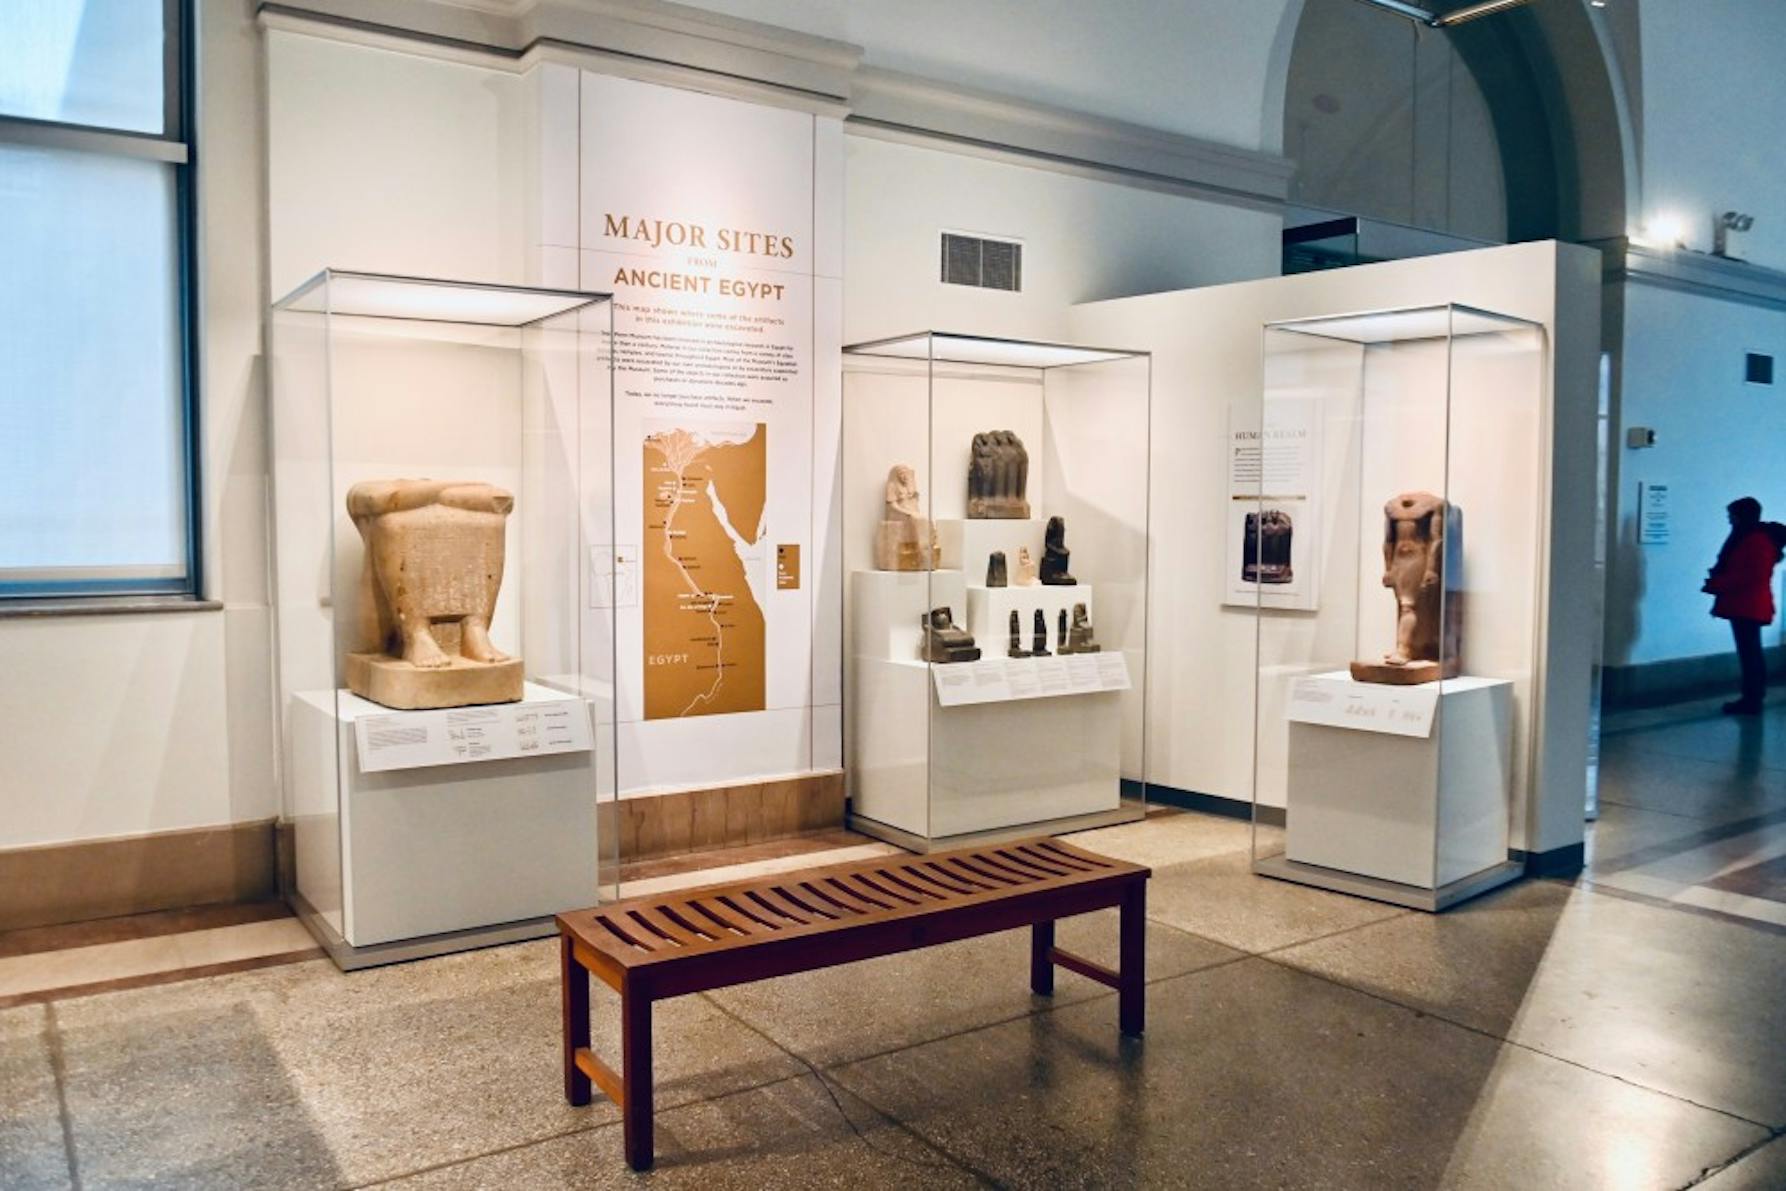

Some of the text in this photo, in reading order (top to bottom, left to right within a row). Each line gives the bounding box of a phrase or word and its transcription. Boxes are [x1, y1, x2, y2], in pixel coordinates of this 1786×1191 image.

[604, 213, 794, 259] MAJOR SITES
[687, 257, 718, 269] FROM
[614, 267, 785, 301] ANCIENT EGYPT
[633, 306, 651, 314] map
[739, 313, 752, 321] the
[648, 653, 689, 666] EGYPT
